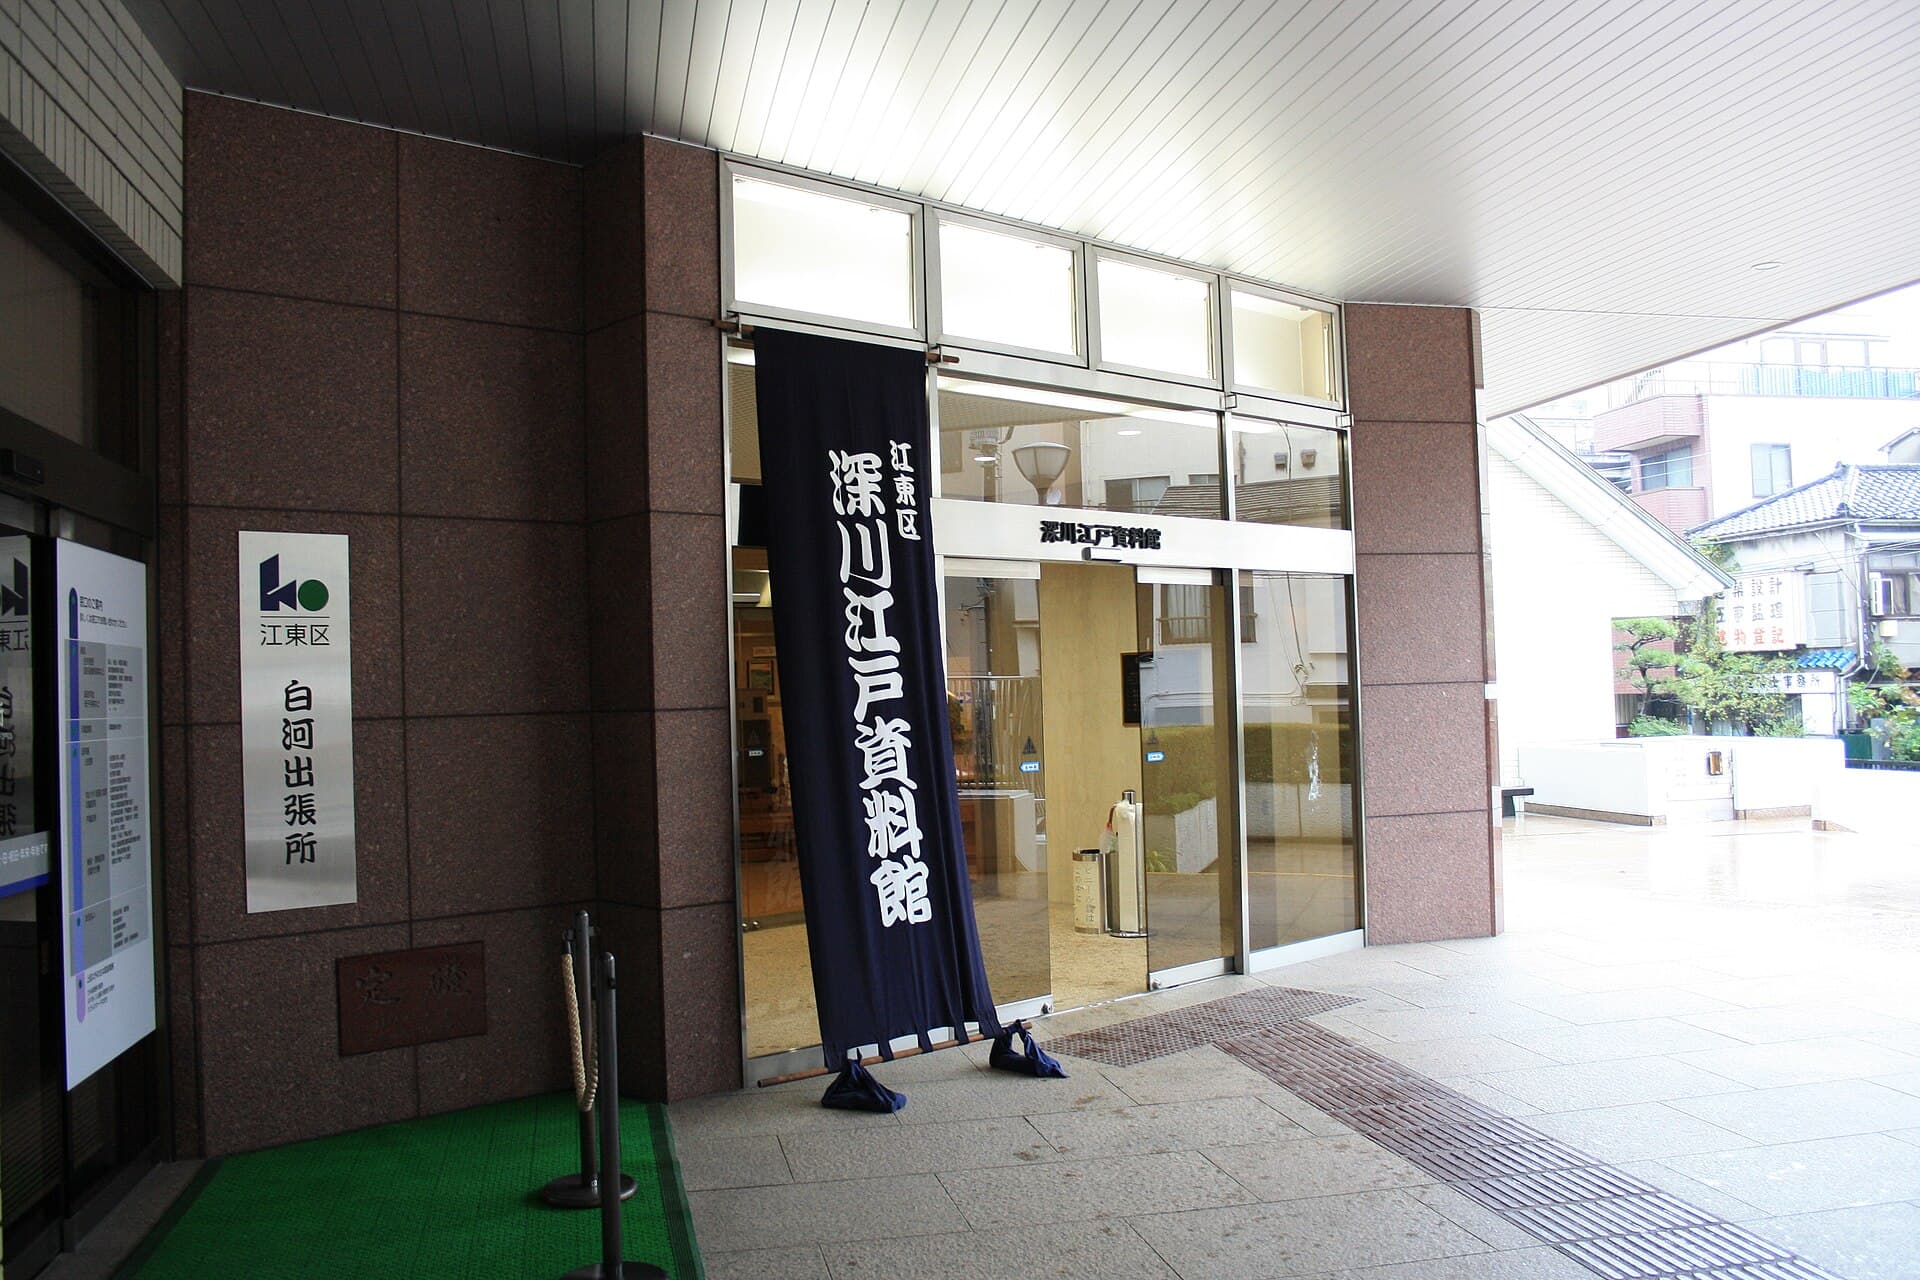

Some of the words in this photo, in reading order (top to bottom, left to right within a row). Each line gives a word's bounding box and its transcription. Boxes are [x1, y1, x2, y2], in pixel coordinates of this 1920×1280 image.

[888, 440, 922, 542] 江東区
[1039, 520, 1162, 552] 深川江戸資料館
[260, 623, 330, 647] 江東区
[828, 449, 933, 928] 深川江戸資料館
[281, 680, 318, 866] 白河出張所
